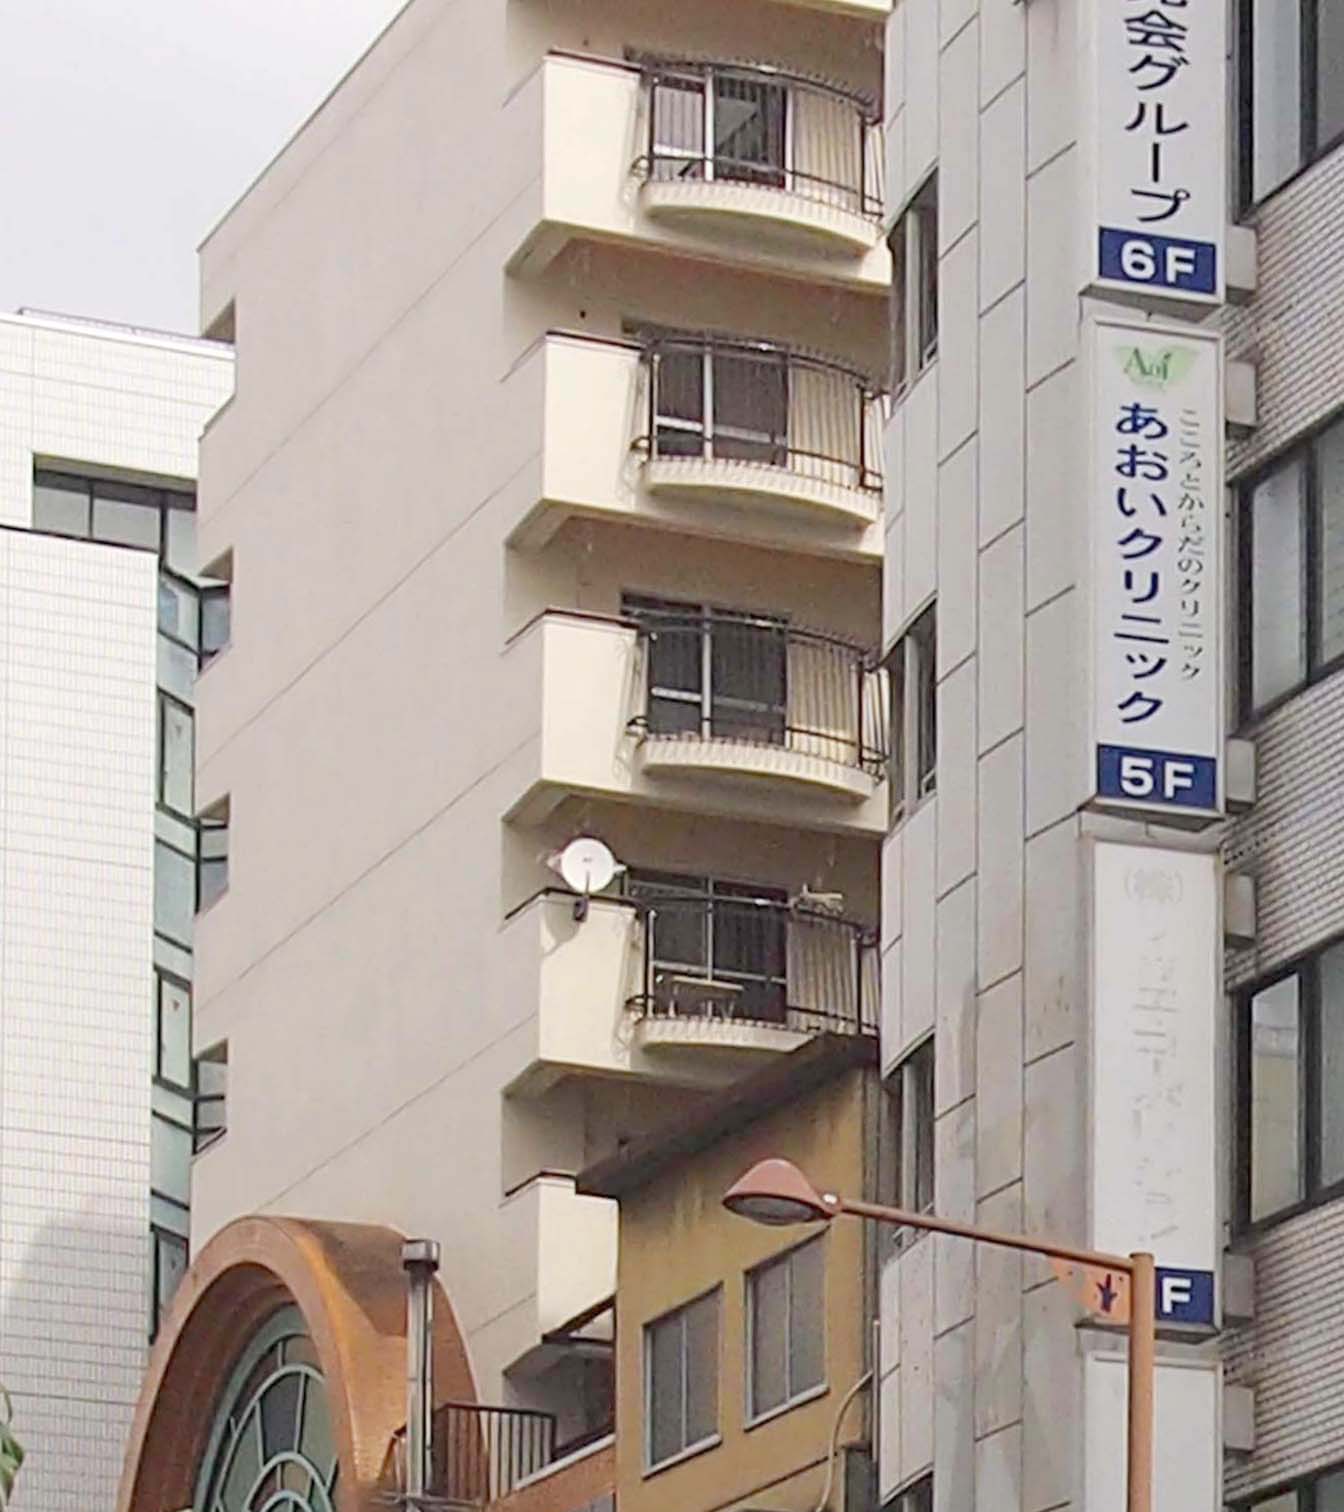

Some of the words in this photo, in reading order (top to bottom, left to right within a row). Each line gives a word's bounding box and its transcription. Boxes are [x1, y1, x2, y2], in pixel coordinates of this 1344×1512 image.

[1123, 0, 1191, 223] 会グループ
[1120, 240, 1196, 284] 6F
[1114, 402, 1170, 724] あおいクリニック
[1120, 757, 1194, 798] 5F
